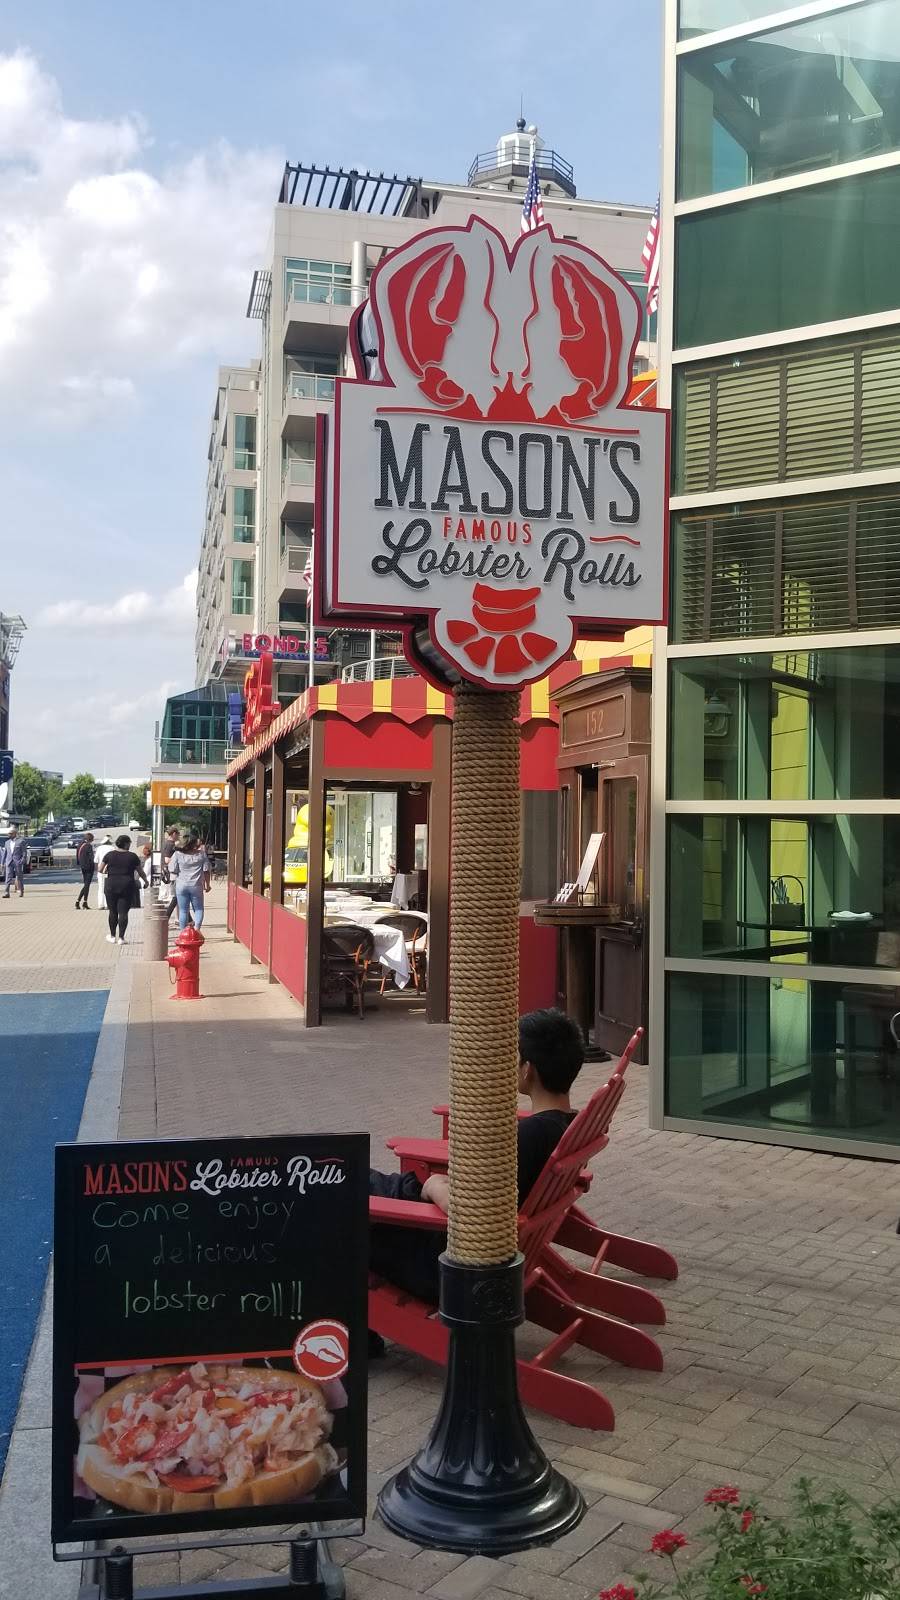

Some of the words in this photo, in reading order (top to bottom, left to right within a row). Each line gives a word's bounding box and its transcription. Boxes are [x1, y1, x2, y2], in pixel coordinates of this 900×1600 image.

[374, 419, 641, 524] MASON'S
[443, 517, 532, 544] FAMOUS
[371, 518, 531, 589] Lobster
[541, 527, 642, 601] Rolls
[243, 633, 299, 653] BOND
[586, 709, 604, 736] 152
[84, 1160, 188, 1195] MASON'S
[190, 1159, 281, 1195] Lobster
[286, 1155, 346, 1194] Rolls
[230, 1156, 279, 1167] FAMOUS
[92, 1201, 190, 1228] Come
[218, 1196, 295, 1237] enjoy
[95, 1244, 111, 1266] a
[153, 1231, 277, 1264] delicious
[125, 1280, 226, 1318] lobster
